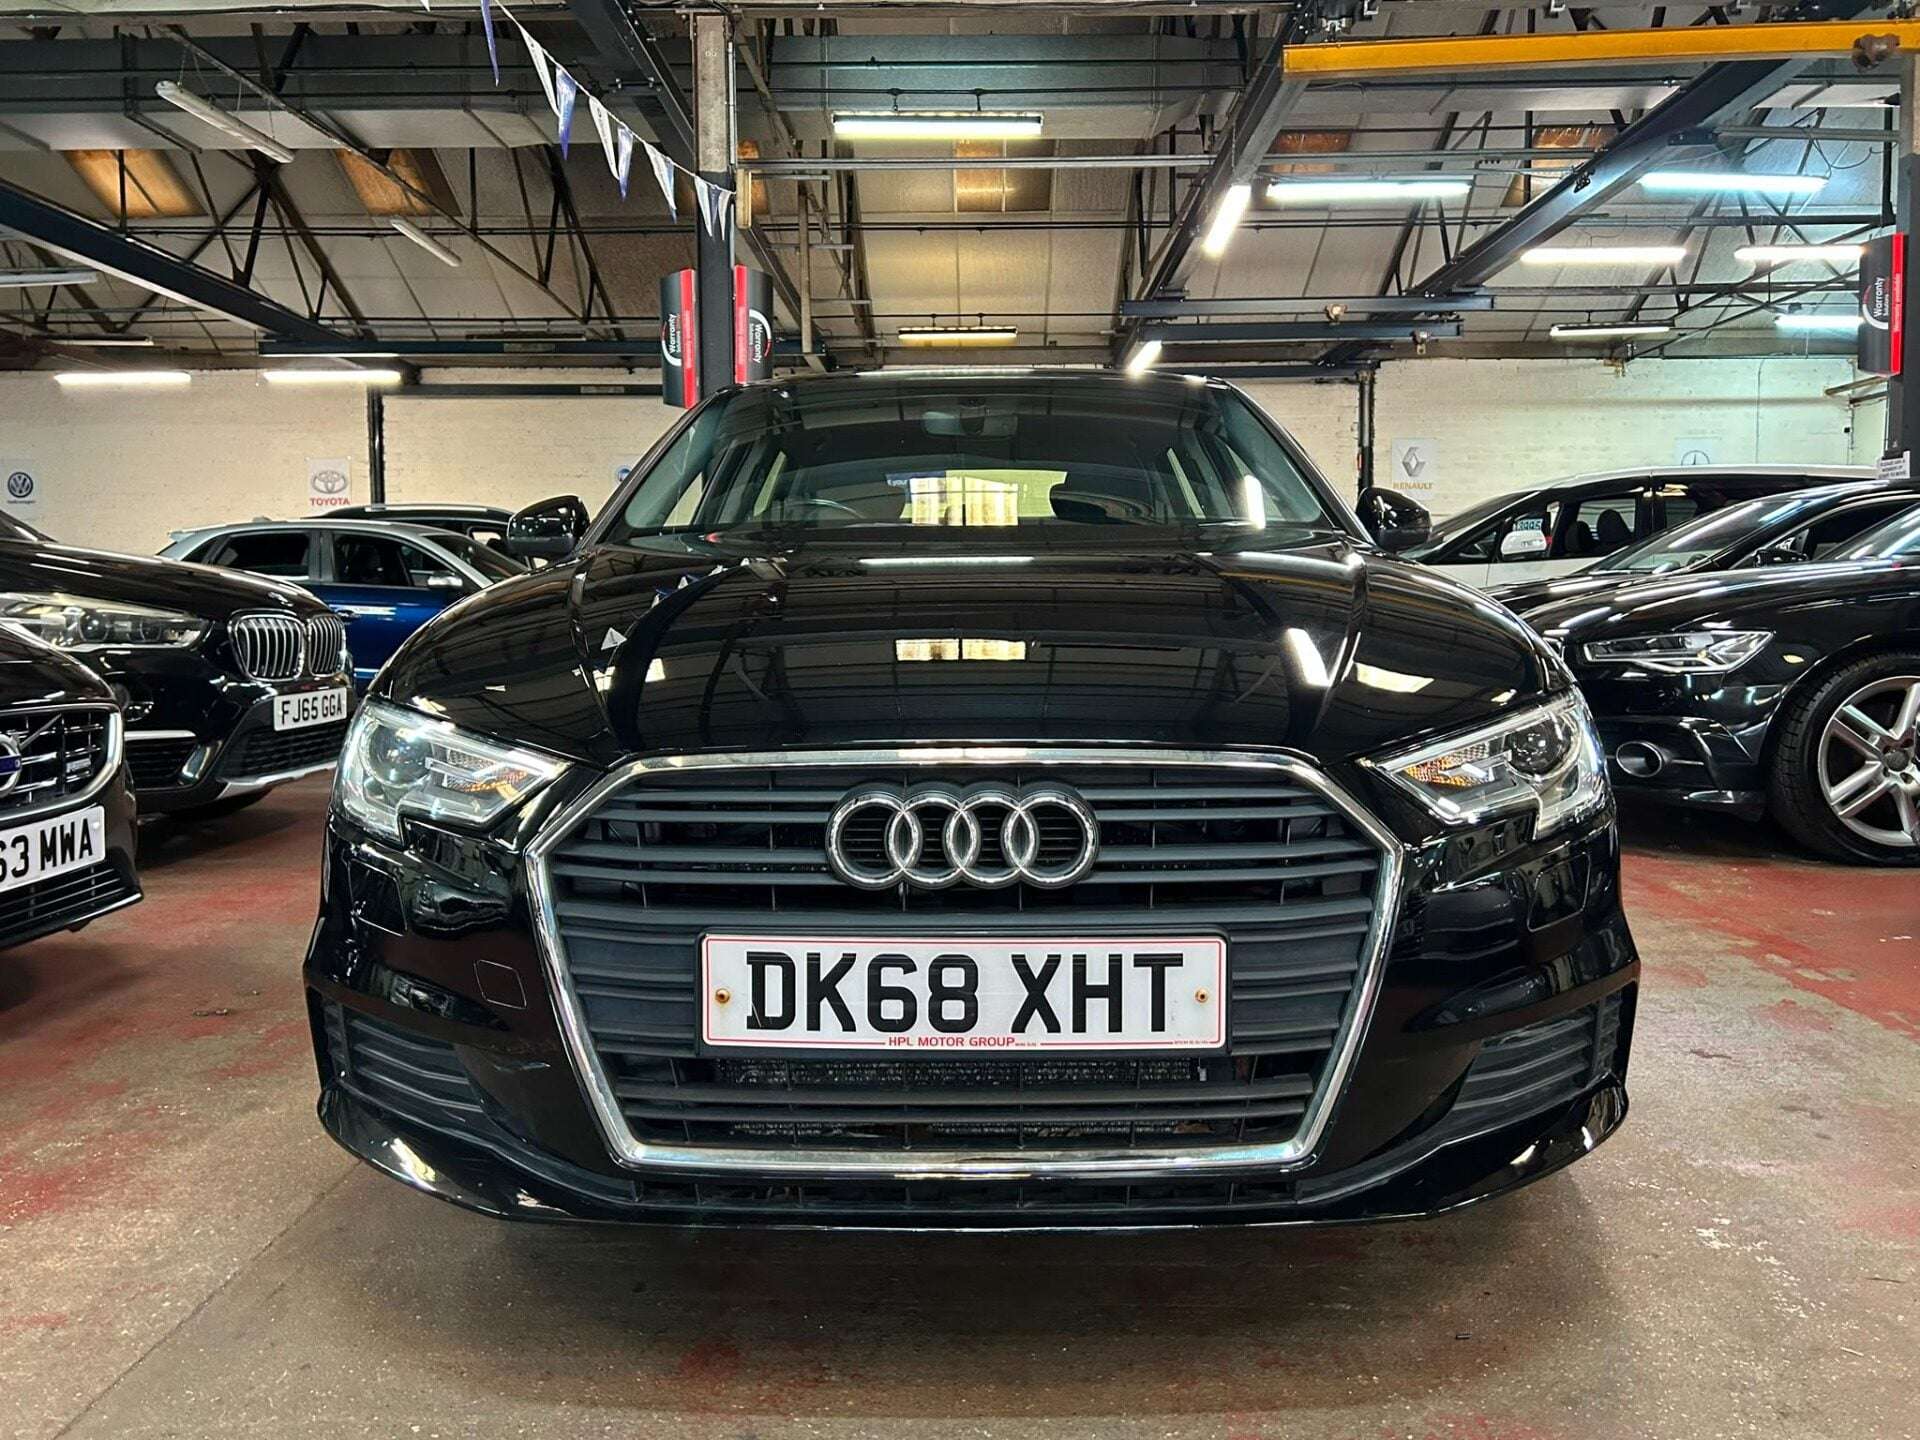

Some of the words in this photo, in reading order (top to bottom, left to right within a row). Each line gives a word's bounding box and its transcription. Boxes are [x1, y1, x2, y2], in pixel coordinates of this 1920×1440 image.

[1874, 277, 1885, 317] Warranty
[668, 314, 676, 353] Warranty
[753, 324, 762, 363] Warranty
[282, 696, 318, 725] FJ65
[322, 693, 342, 717] GGA
[40, 818, 93, 871] MWA
[746, 951, 978, 1034] DK68
[1011, 952, 1184, 1034] XHT
[889, 1036, 913, 1046] HPL
[918, 1036, 965, 1046] MOTOR
[969, 1036, 1015, 1046] GROUP
